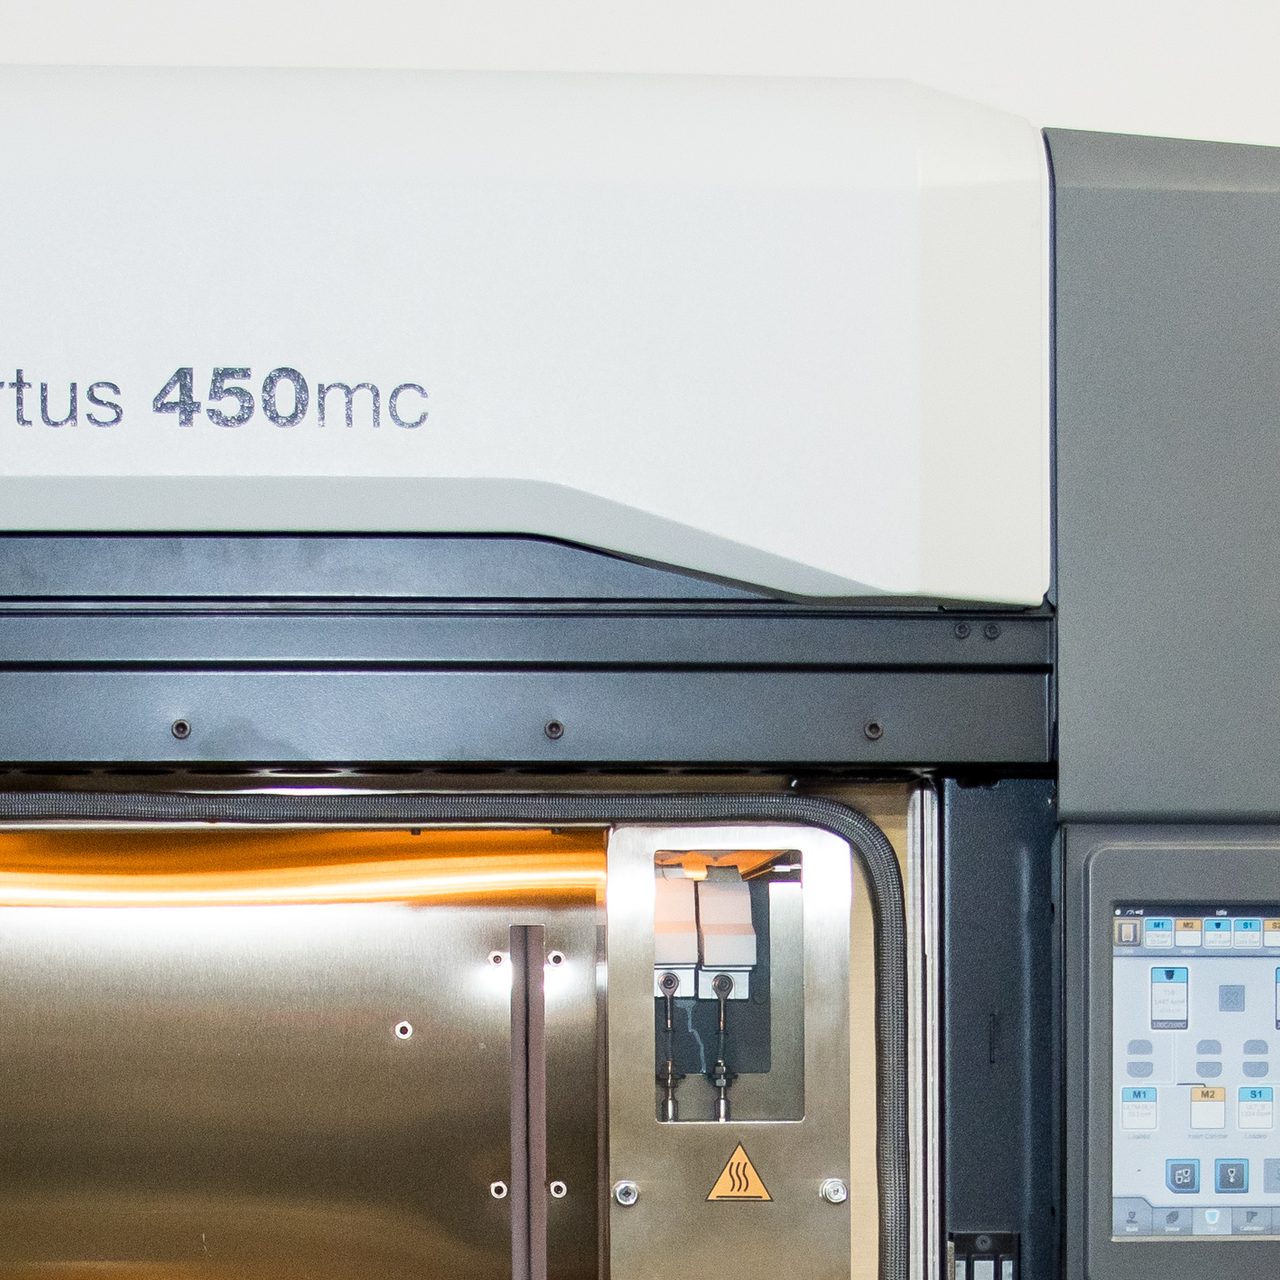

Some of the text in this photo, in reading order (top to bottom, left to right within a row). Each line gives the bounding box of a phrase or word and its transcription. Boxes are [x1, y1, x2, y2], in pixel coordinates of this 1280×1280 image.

[152, 367, 429, 429] 450mc
[1132, 1090, 1147, 1099] M1
[1200, 1090, 1215, 1099] M2
[1250, 1090, 1262, 1099] S1
